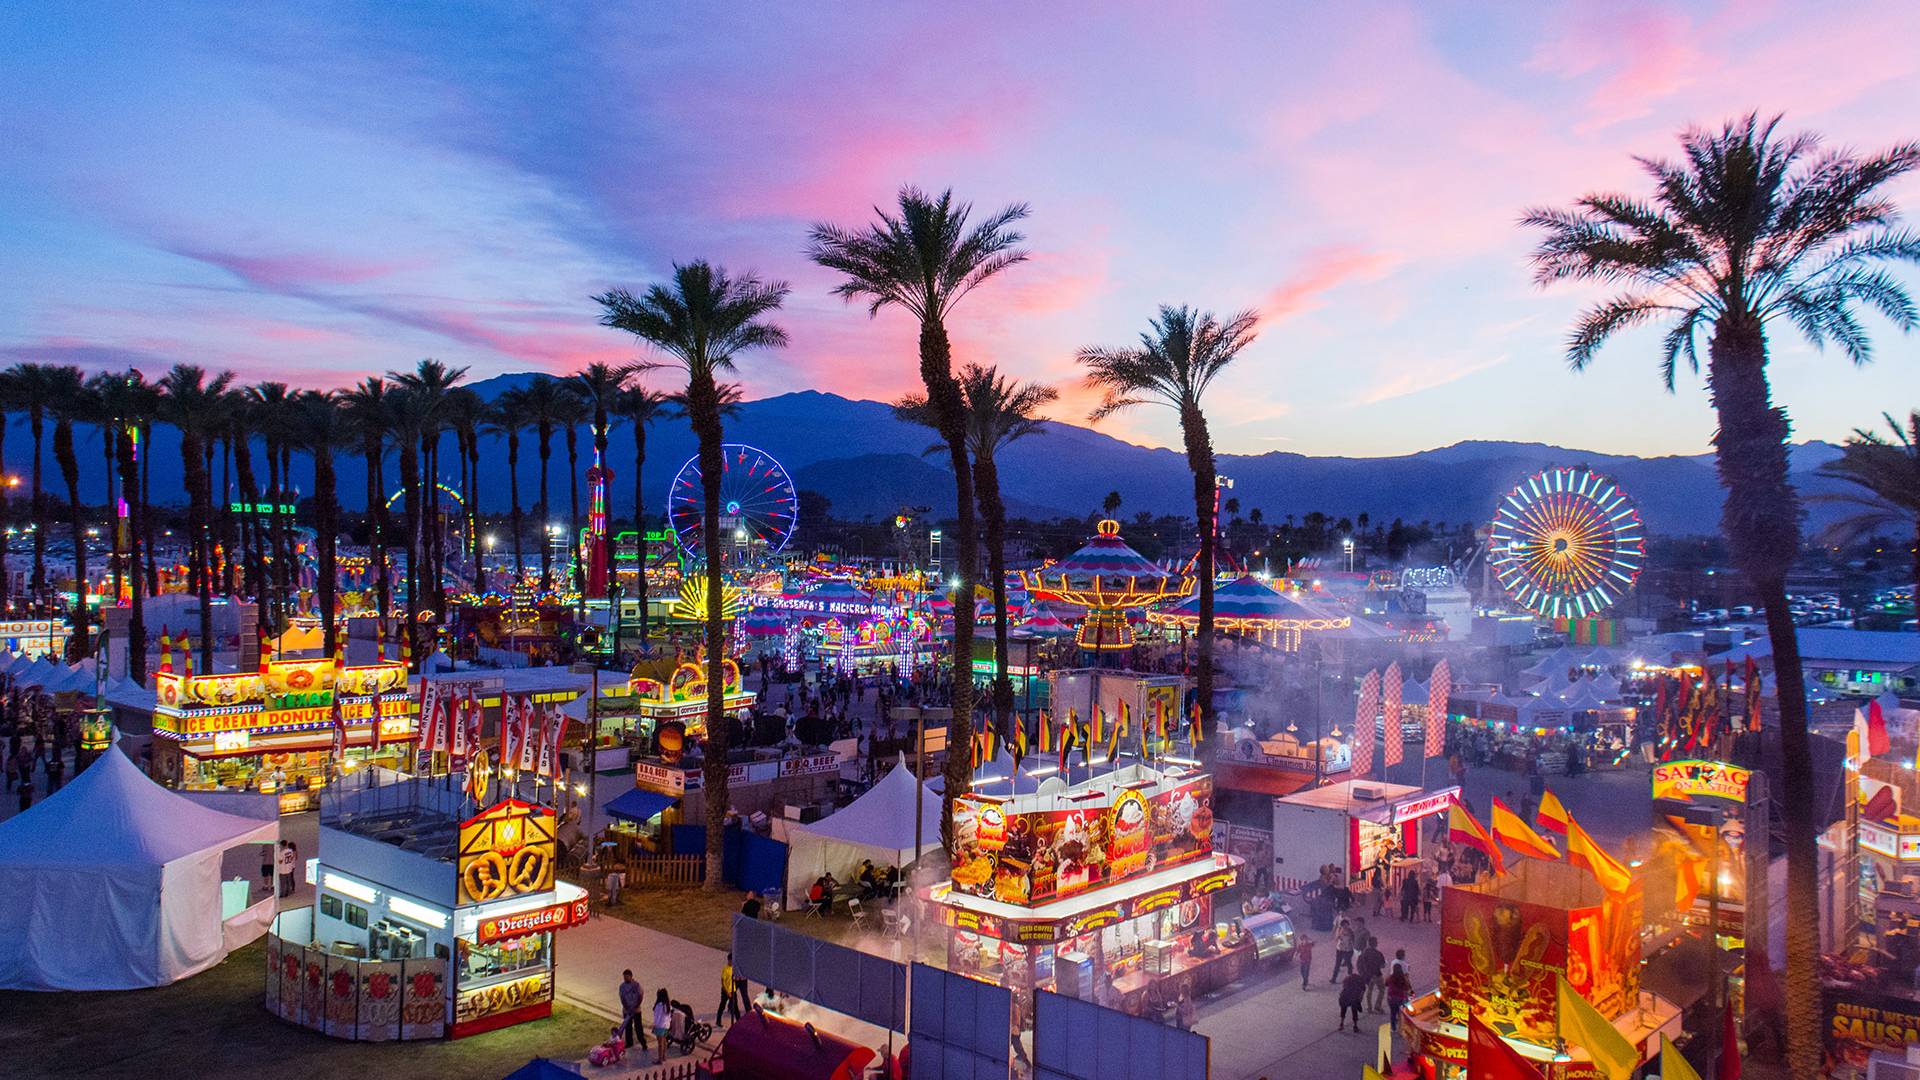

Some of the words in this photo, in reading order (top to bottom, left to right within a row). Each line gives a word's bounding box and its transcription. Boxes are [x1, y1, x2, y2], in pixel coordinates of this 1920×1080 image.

[647, 531, 661, 539] TOP
[0, 622, 63, 632] HOTOS
[274, 690, 332, 709] TEXAS
[184, 718, 206, 734] ICE
[213, 713, 258, 730] CREAM
[268, 708, 333, 725] DONUTS
[344, 705, 362, 718] ICE
[814, 756, 835, 766] BEEF
[1265, 756, 1303, 769] Cinnamon
[1306, 761, 1324, 772] Ros
[655, 767, 668, 778] BEEF
[1674, 781, 1691, 790] ON
[1696, 781, 1705, 790] A
[1708, 783, 1745, 796] STICK
[497, 910, 552, 934] Pretzels
[1446, 936, 1463, 946] Corn
[1491, 994, 1520, 1008] Nachos
[1836, 1002, 1880, 1020] GIANT
